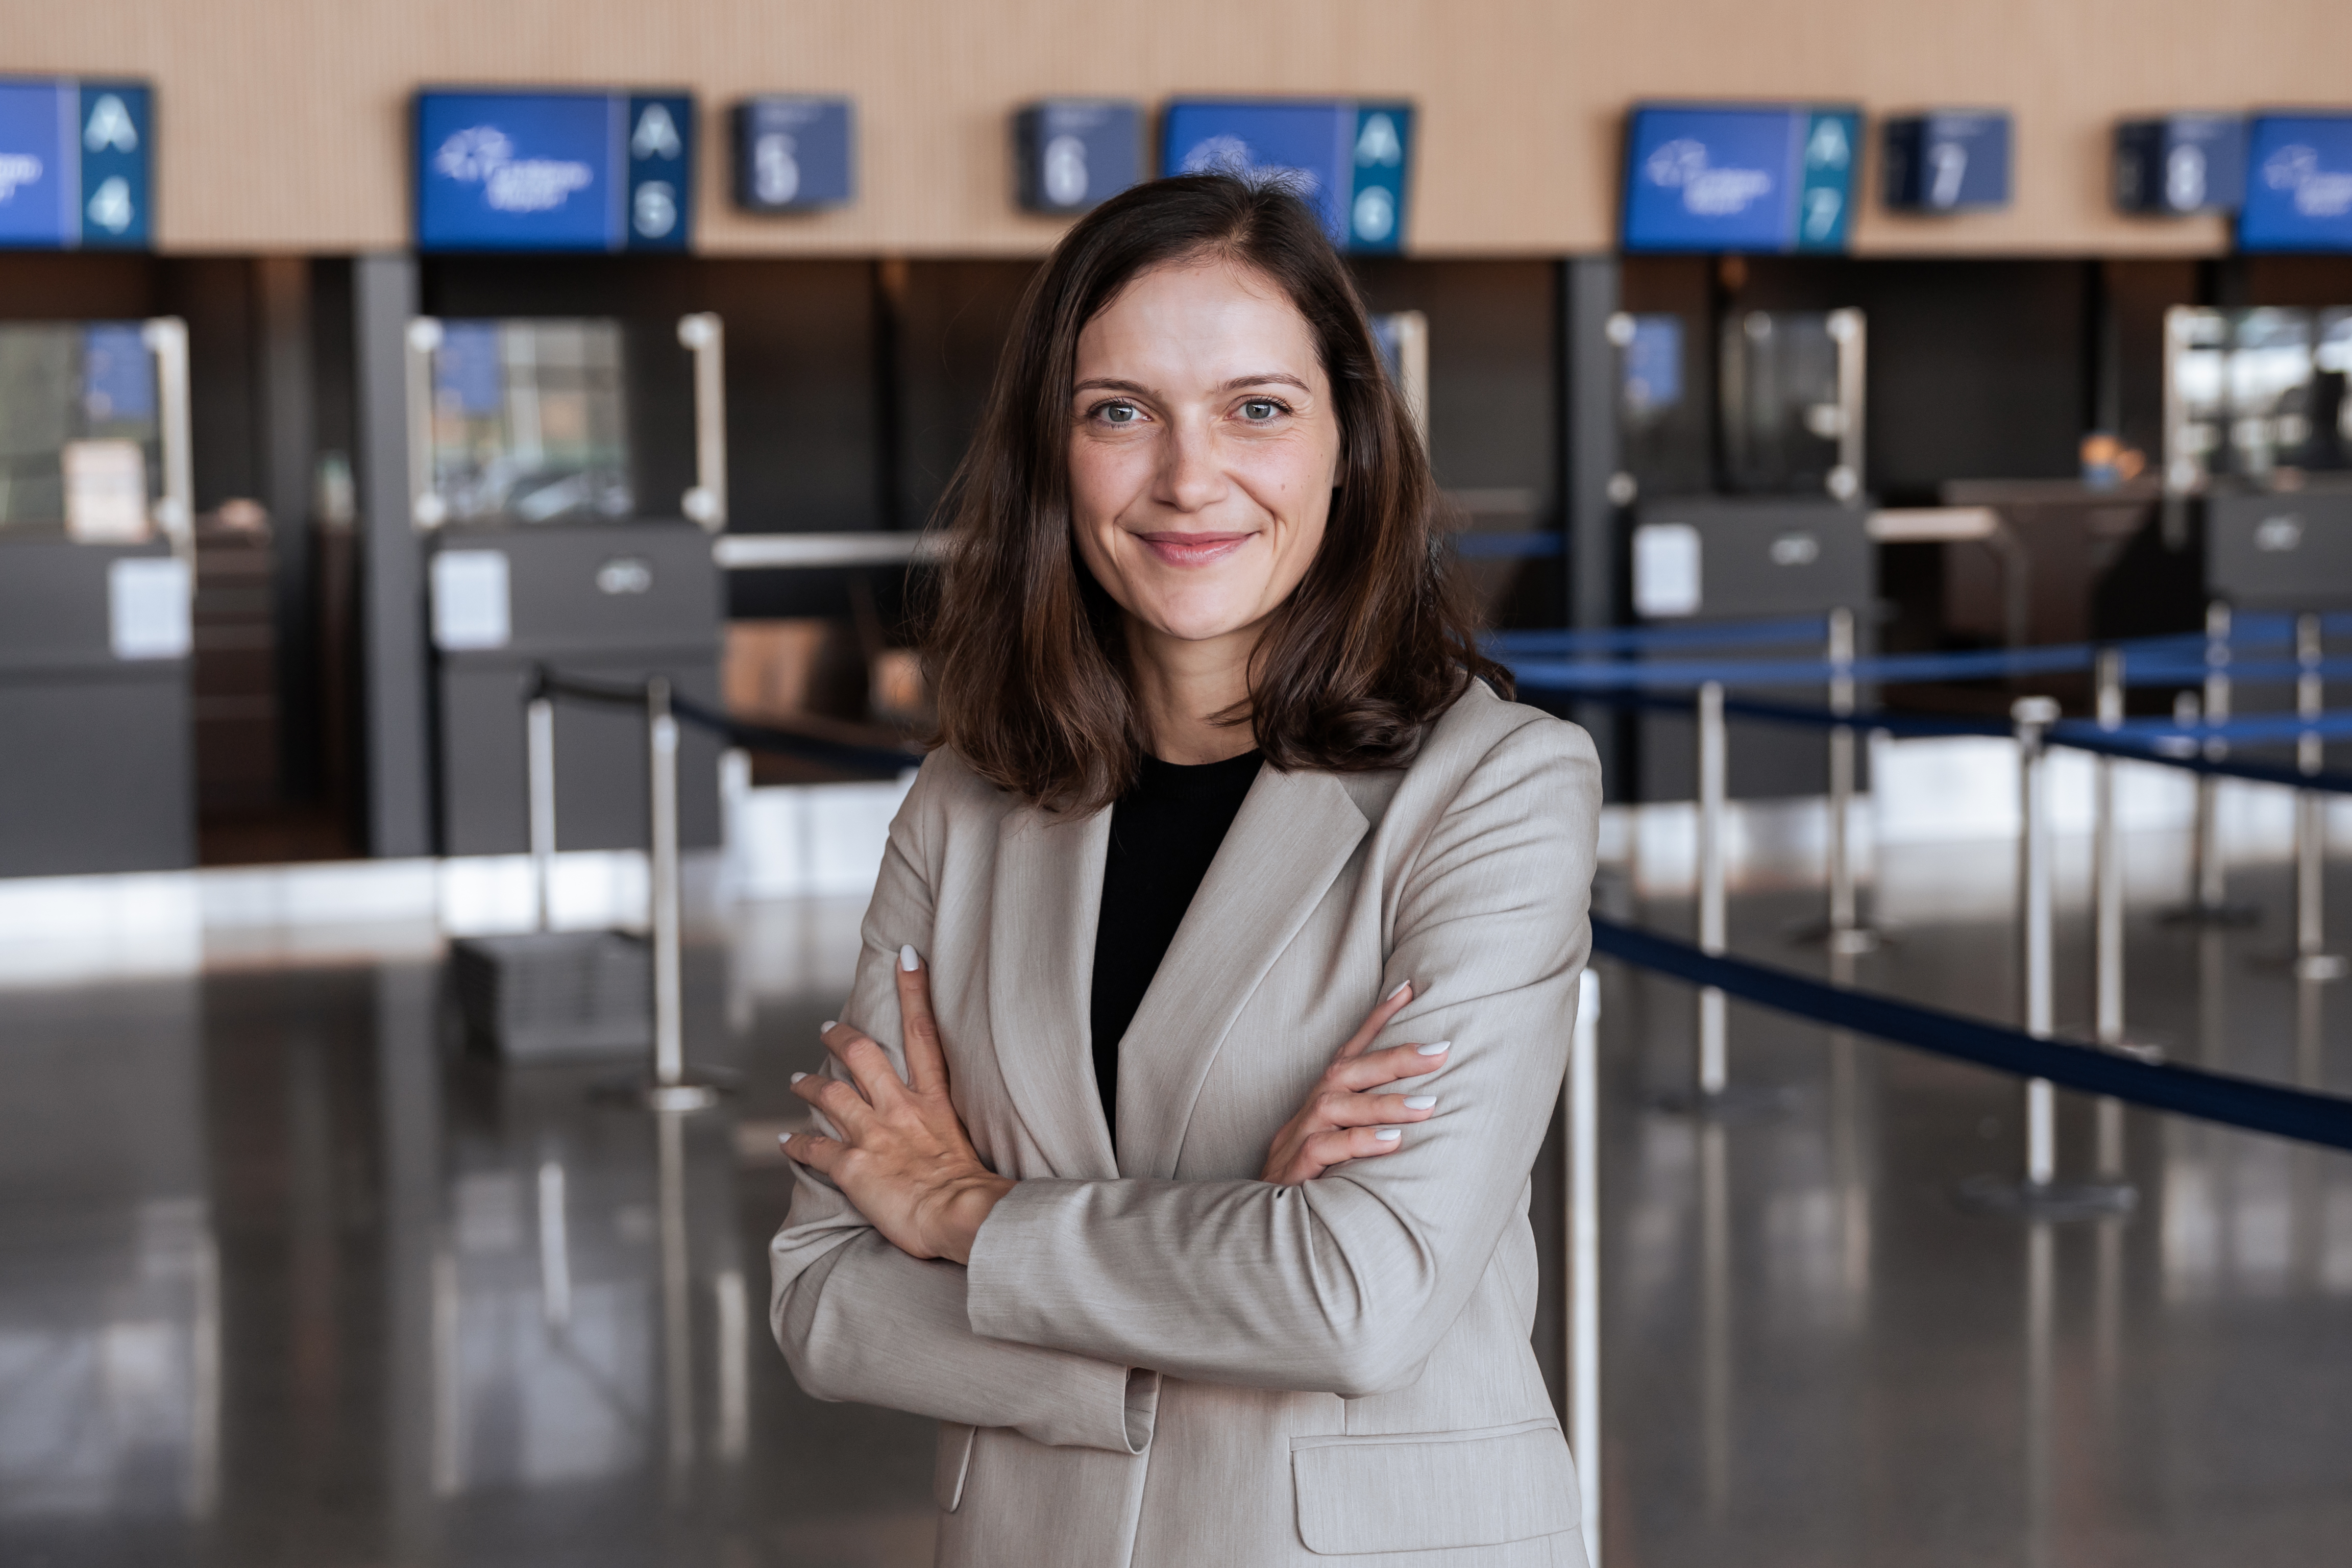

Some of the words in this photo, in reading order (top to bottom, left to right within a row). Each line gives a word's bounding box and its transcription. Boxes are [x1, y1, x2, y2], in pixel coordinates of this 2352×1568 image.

[84, 93, 137, 153] A
[632, 102, 681, 160] A
[1355, 112, 1402, 168] A
[1806, 117, 1850, 170] A
[1043, 135, 1088, 206] 6
[1929, 142, 1969, 208] 7
[1804, 186, 1842, 241] 7
